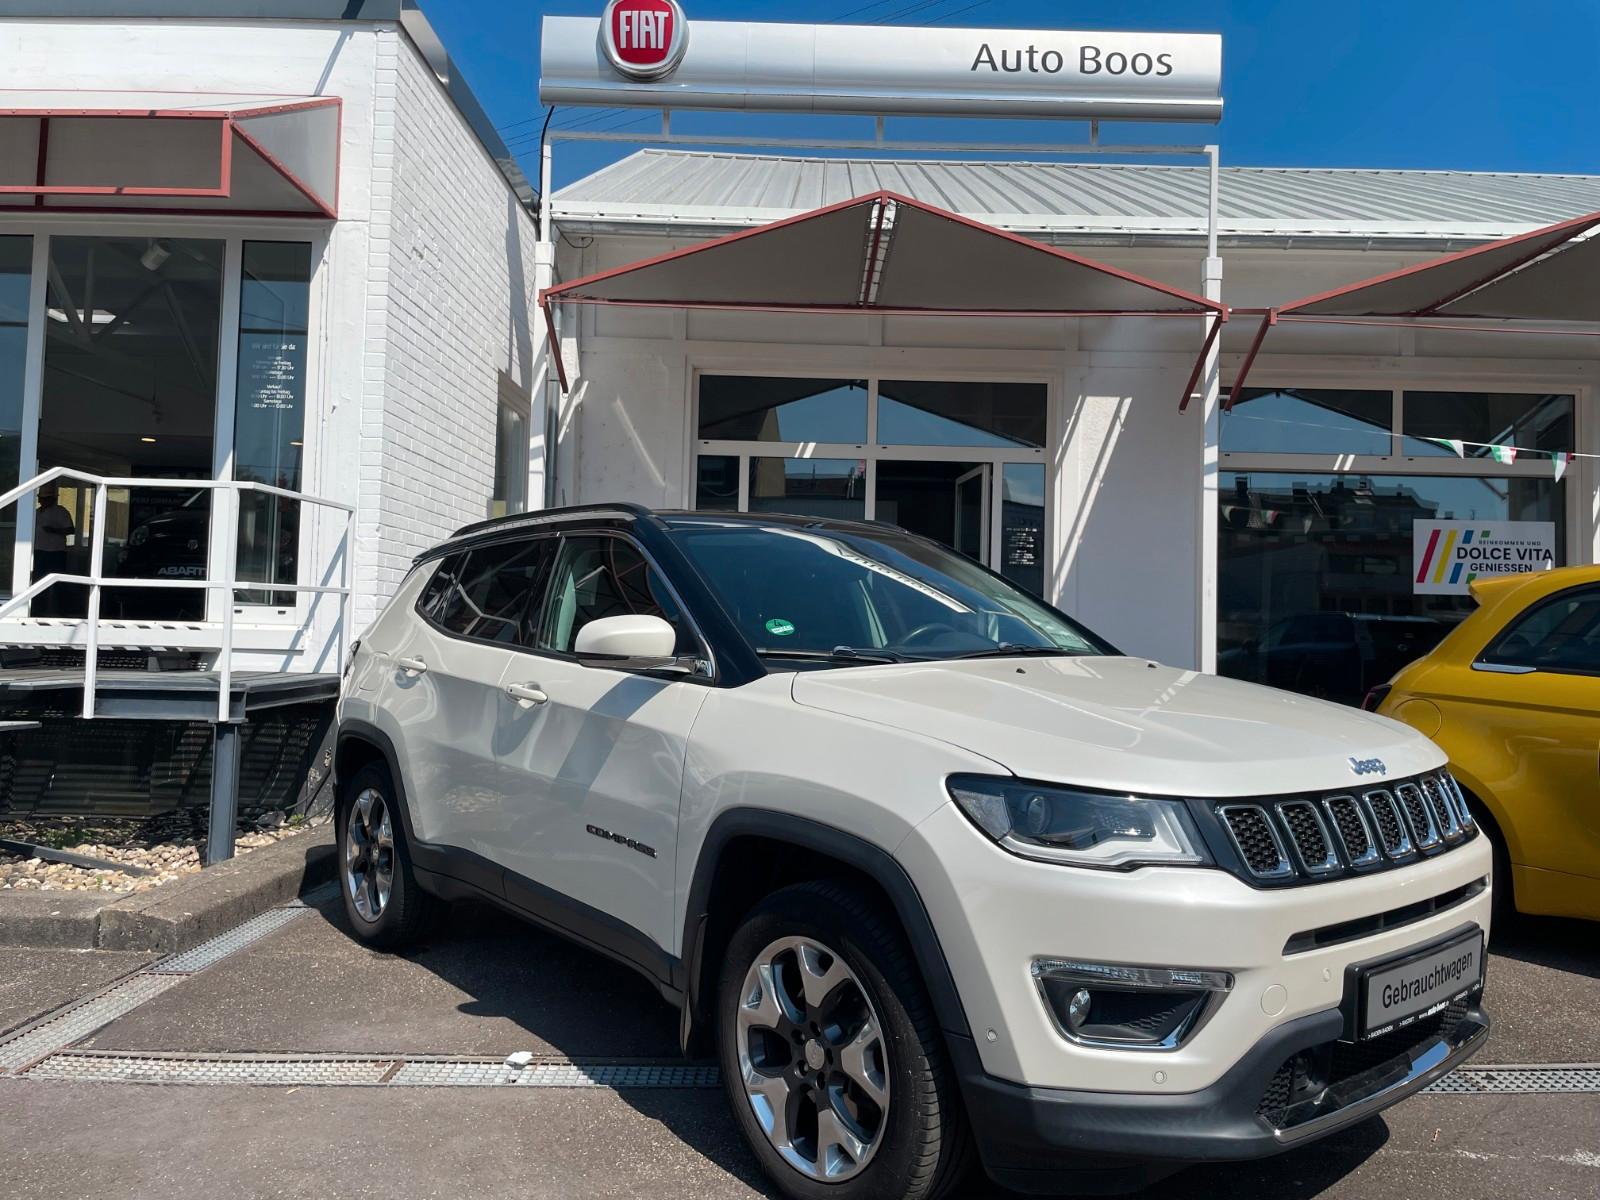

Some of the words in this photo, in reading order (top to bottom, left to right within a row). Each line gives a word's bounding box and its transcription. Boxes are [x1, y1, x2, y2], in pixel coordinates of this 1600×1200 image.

[619, 10, 670, 49] FIAT
[970, 43, 1064, 74] Auto
[1079, 45, 1173, 77] Boos
[1456, 546, 1512, 560] DOLCE
[1516, 548, 1554, 561] VITA
[158, 566, 207, 576] ABART
[1470, 562, 1533, 573] GENIESSEN
[1348, 757, 1386, 776] Jeep
[586, 824, 658, 860] COMPASS
[1382, 951, 1473, 1009] Gebrauchtwagen
